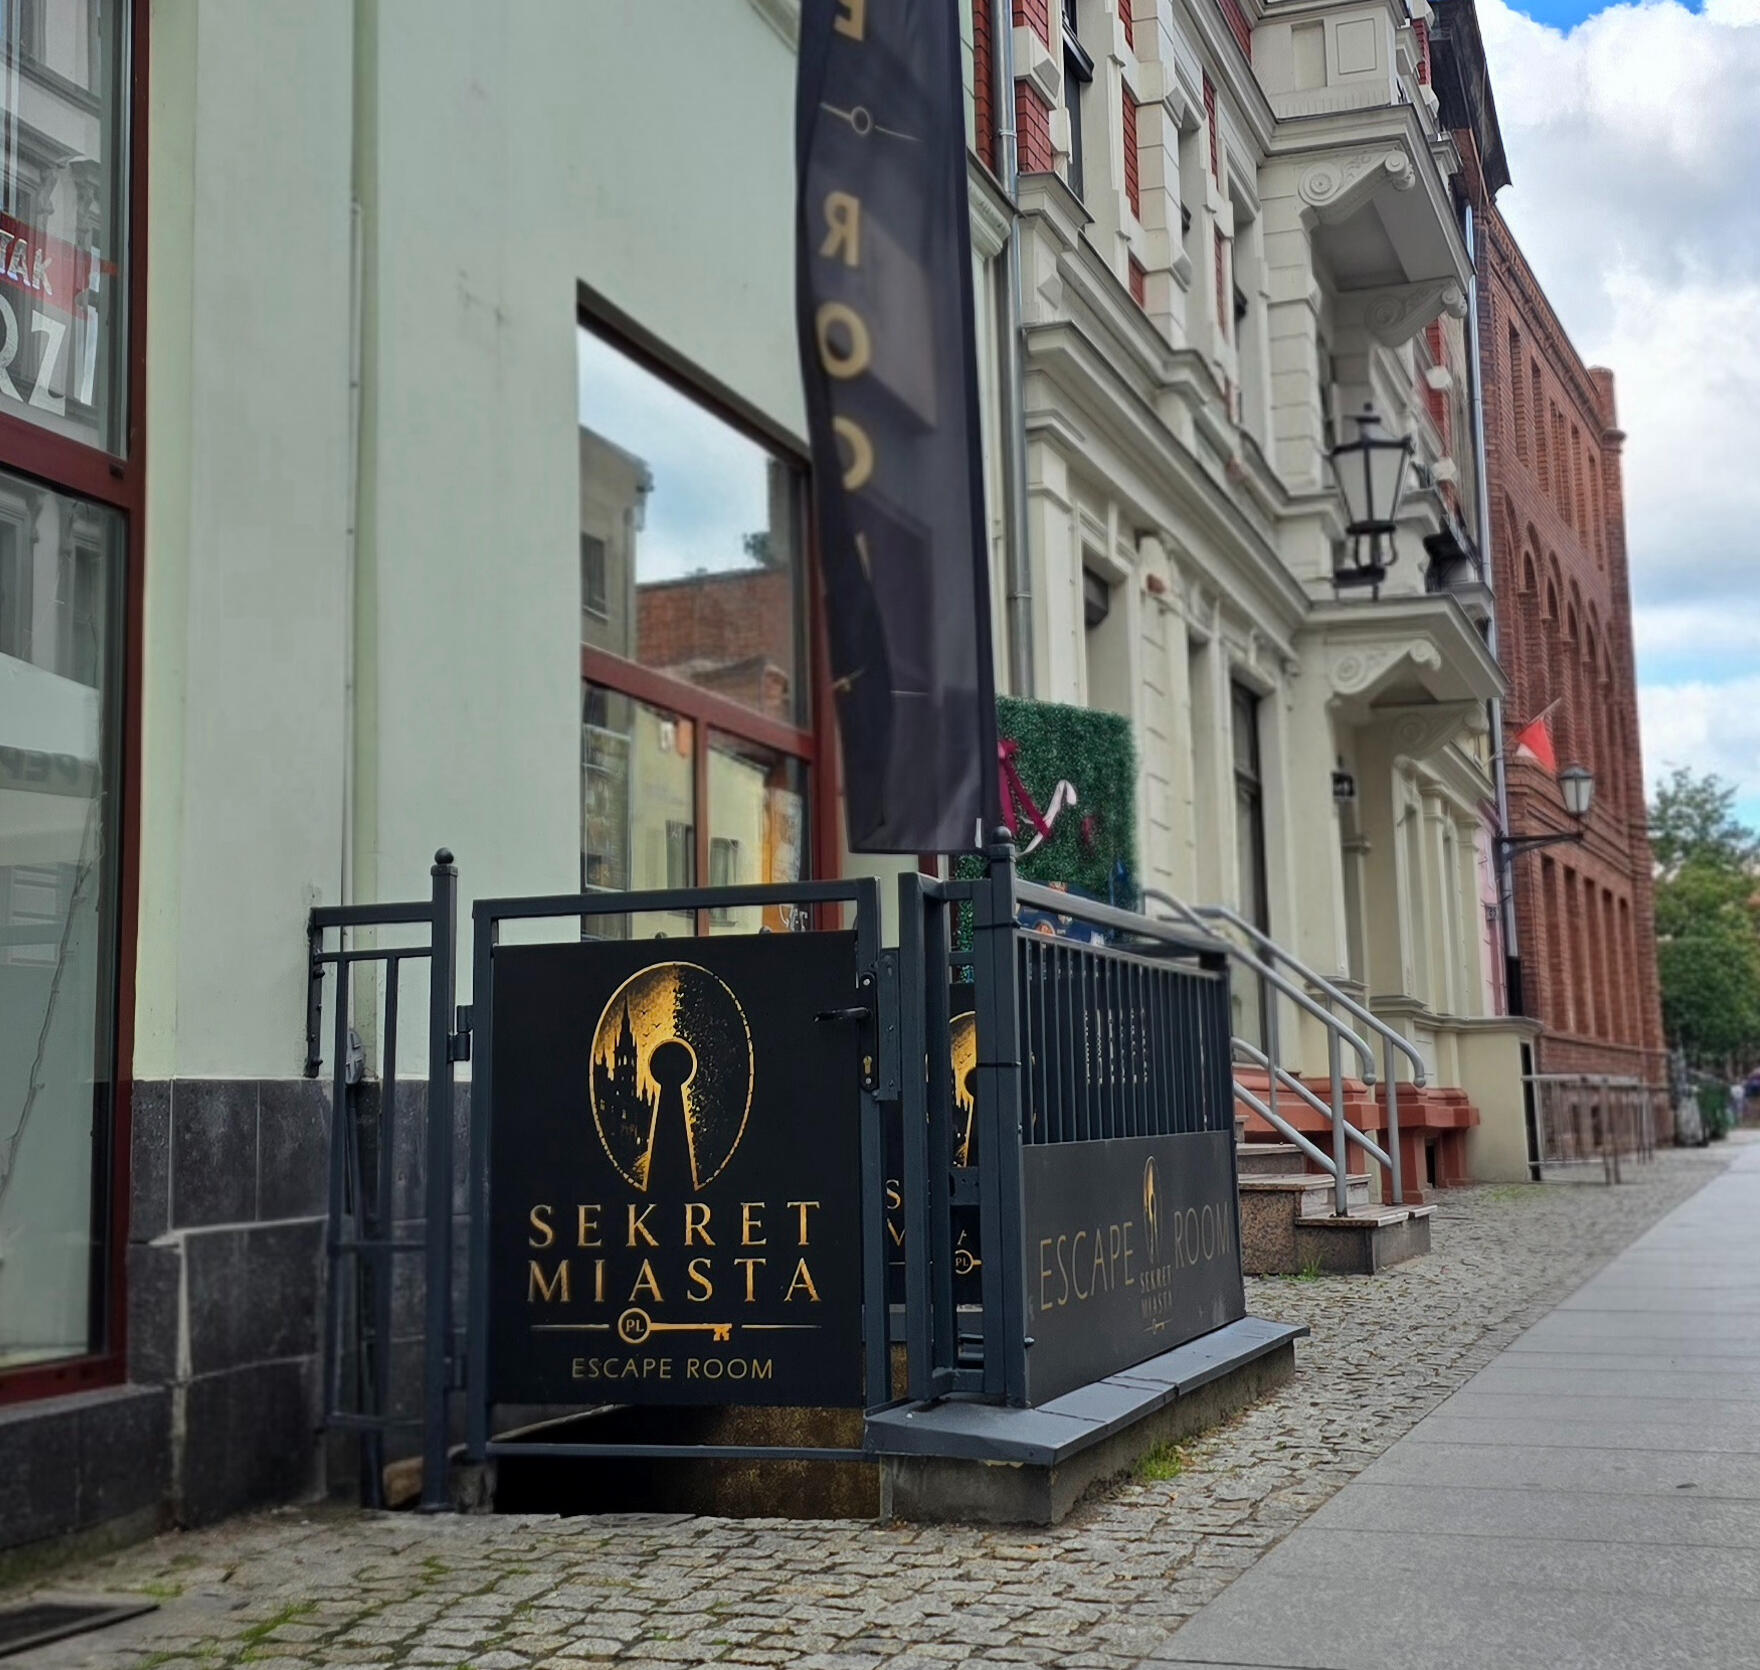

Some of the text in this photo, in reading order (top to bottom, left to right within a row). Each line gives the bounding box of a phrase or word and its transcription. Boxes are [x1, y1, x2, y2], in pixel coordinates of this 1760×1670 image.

[528, 1201, 821, 1248] SEKRET
[1040, 1202, 1231, 1311] ESCAPE ROOM
[527, 1257, 822, 1303] MIASTA
[625, 1319, 645, 1333] PL
[571, 1357, 774, 1380] ESCAPE ROOM
